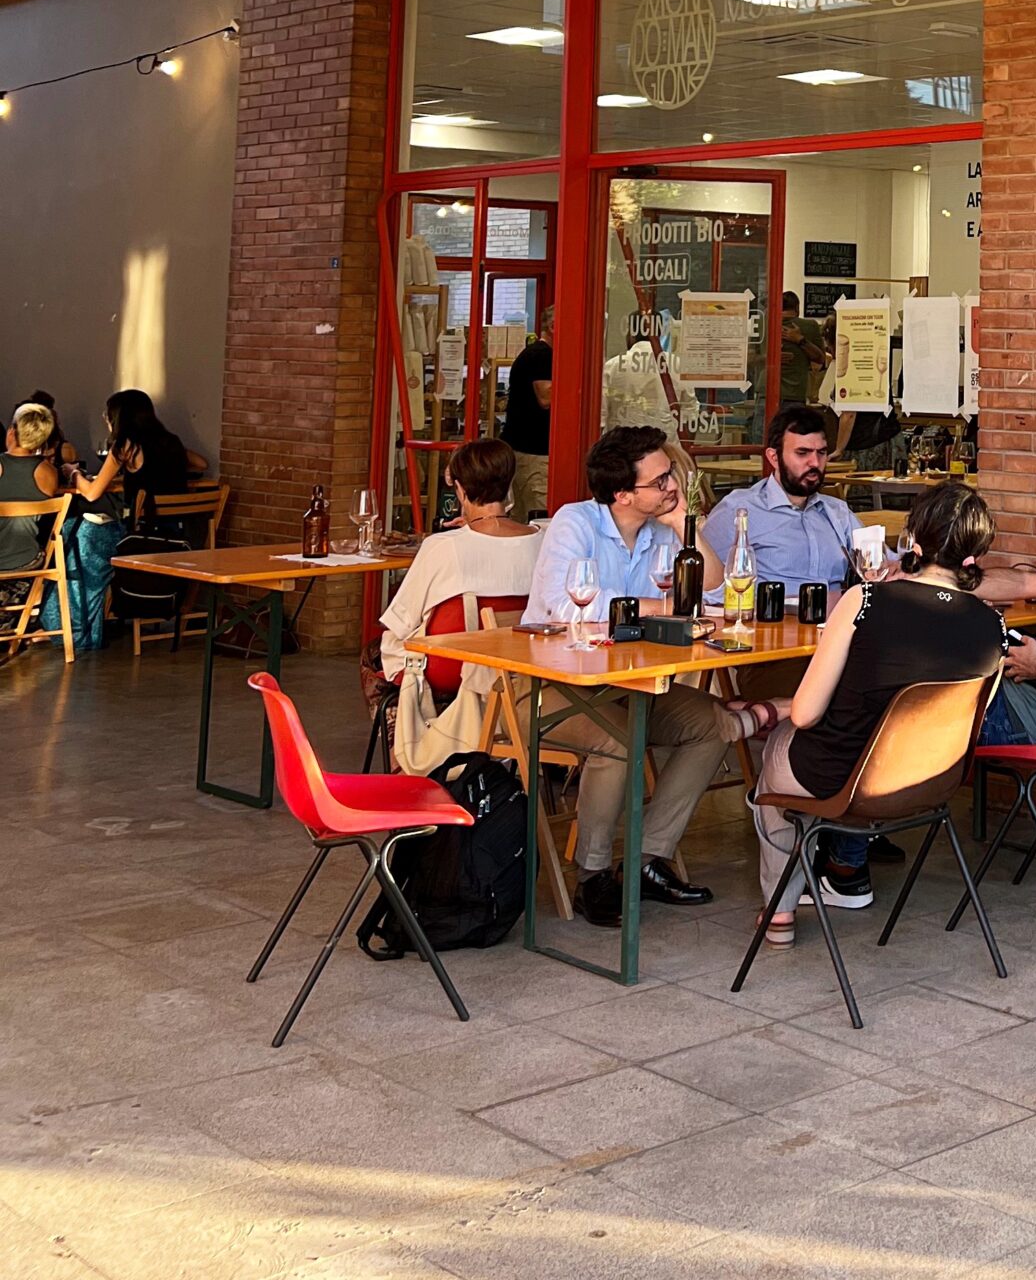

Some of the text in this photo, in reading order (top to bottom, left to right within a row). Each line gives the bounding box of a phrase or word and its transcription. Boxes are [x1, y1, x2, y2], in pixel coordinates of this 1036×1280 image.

[623, 220, 724, 246] PRODOTTI BIO
[636, 258, 687, 281] LOCALI
